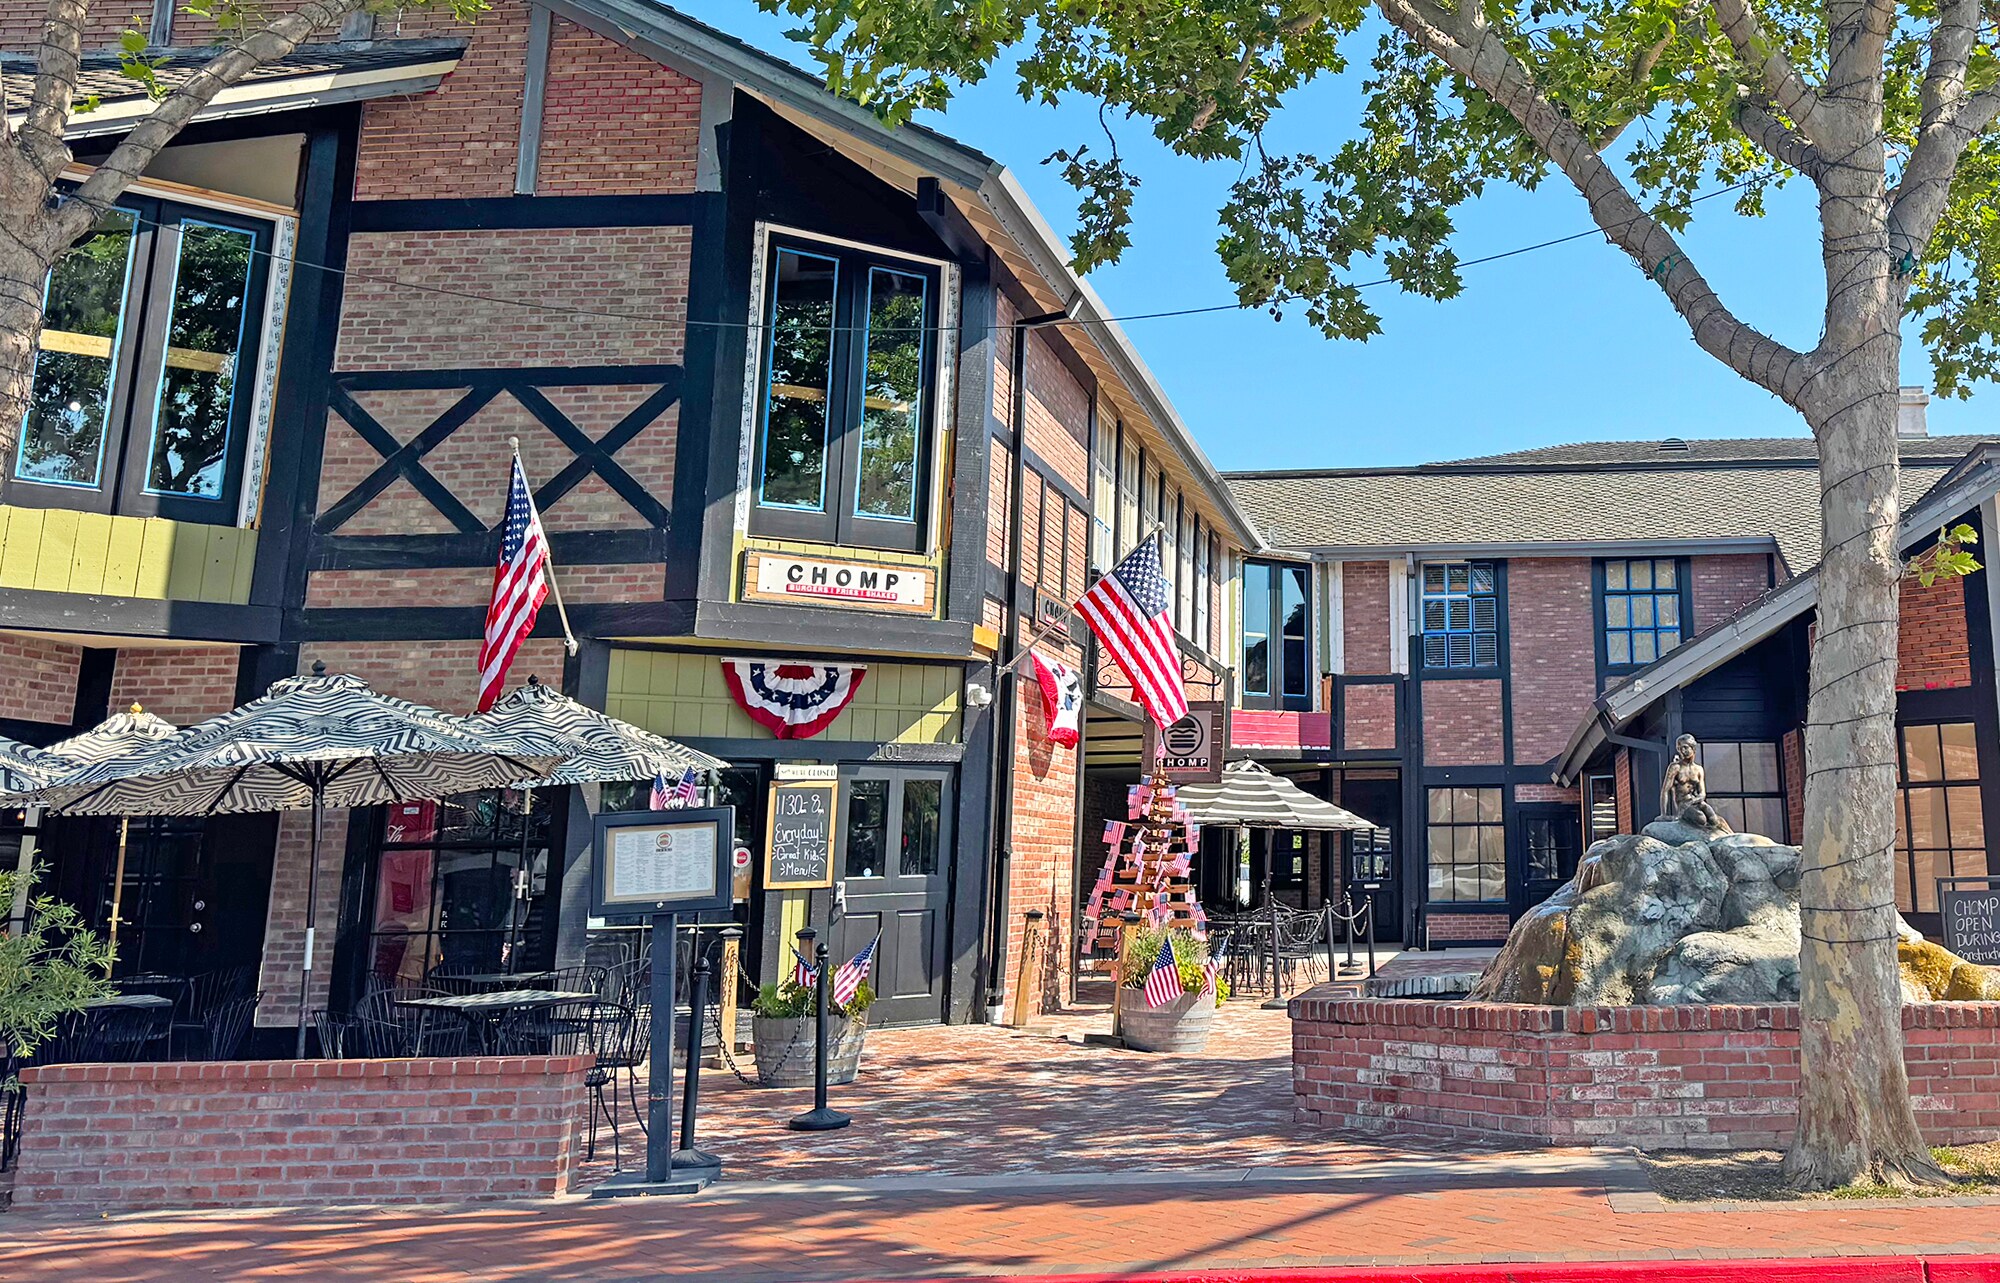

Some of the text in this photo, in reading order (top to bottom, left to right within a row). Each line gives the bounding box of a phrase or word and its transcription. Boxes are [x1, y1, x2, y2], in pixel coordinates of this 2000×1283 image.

[787, 564, 899, 590] CHOMP
[788, 584, 896, 599] BURGERS FRIES SHAKES
[876, 744, 902, 760] 101
[1156, 758, 1208, 767] CHOMP
[808, 769, 836, 777] CLOSED
[775, 822, 823, 849] Everyday!
[776, 846, 820, 861] Great Kids
[785, 862, 811, 877] Menu!
[1954, 897, 1999, 916] CHOMP
[1955, 916, 1993, 932] OPEN
[1955, 931, 2000, 948] DURING
